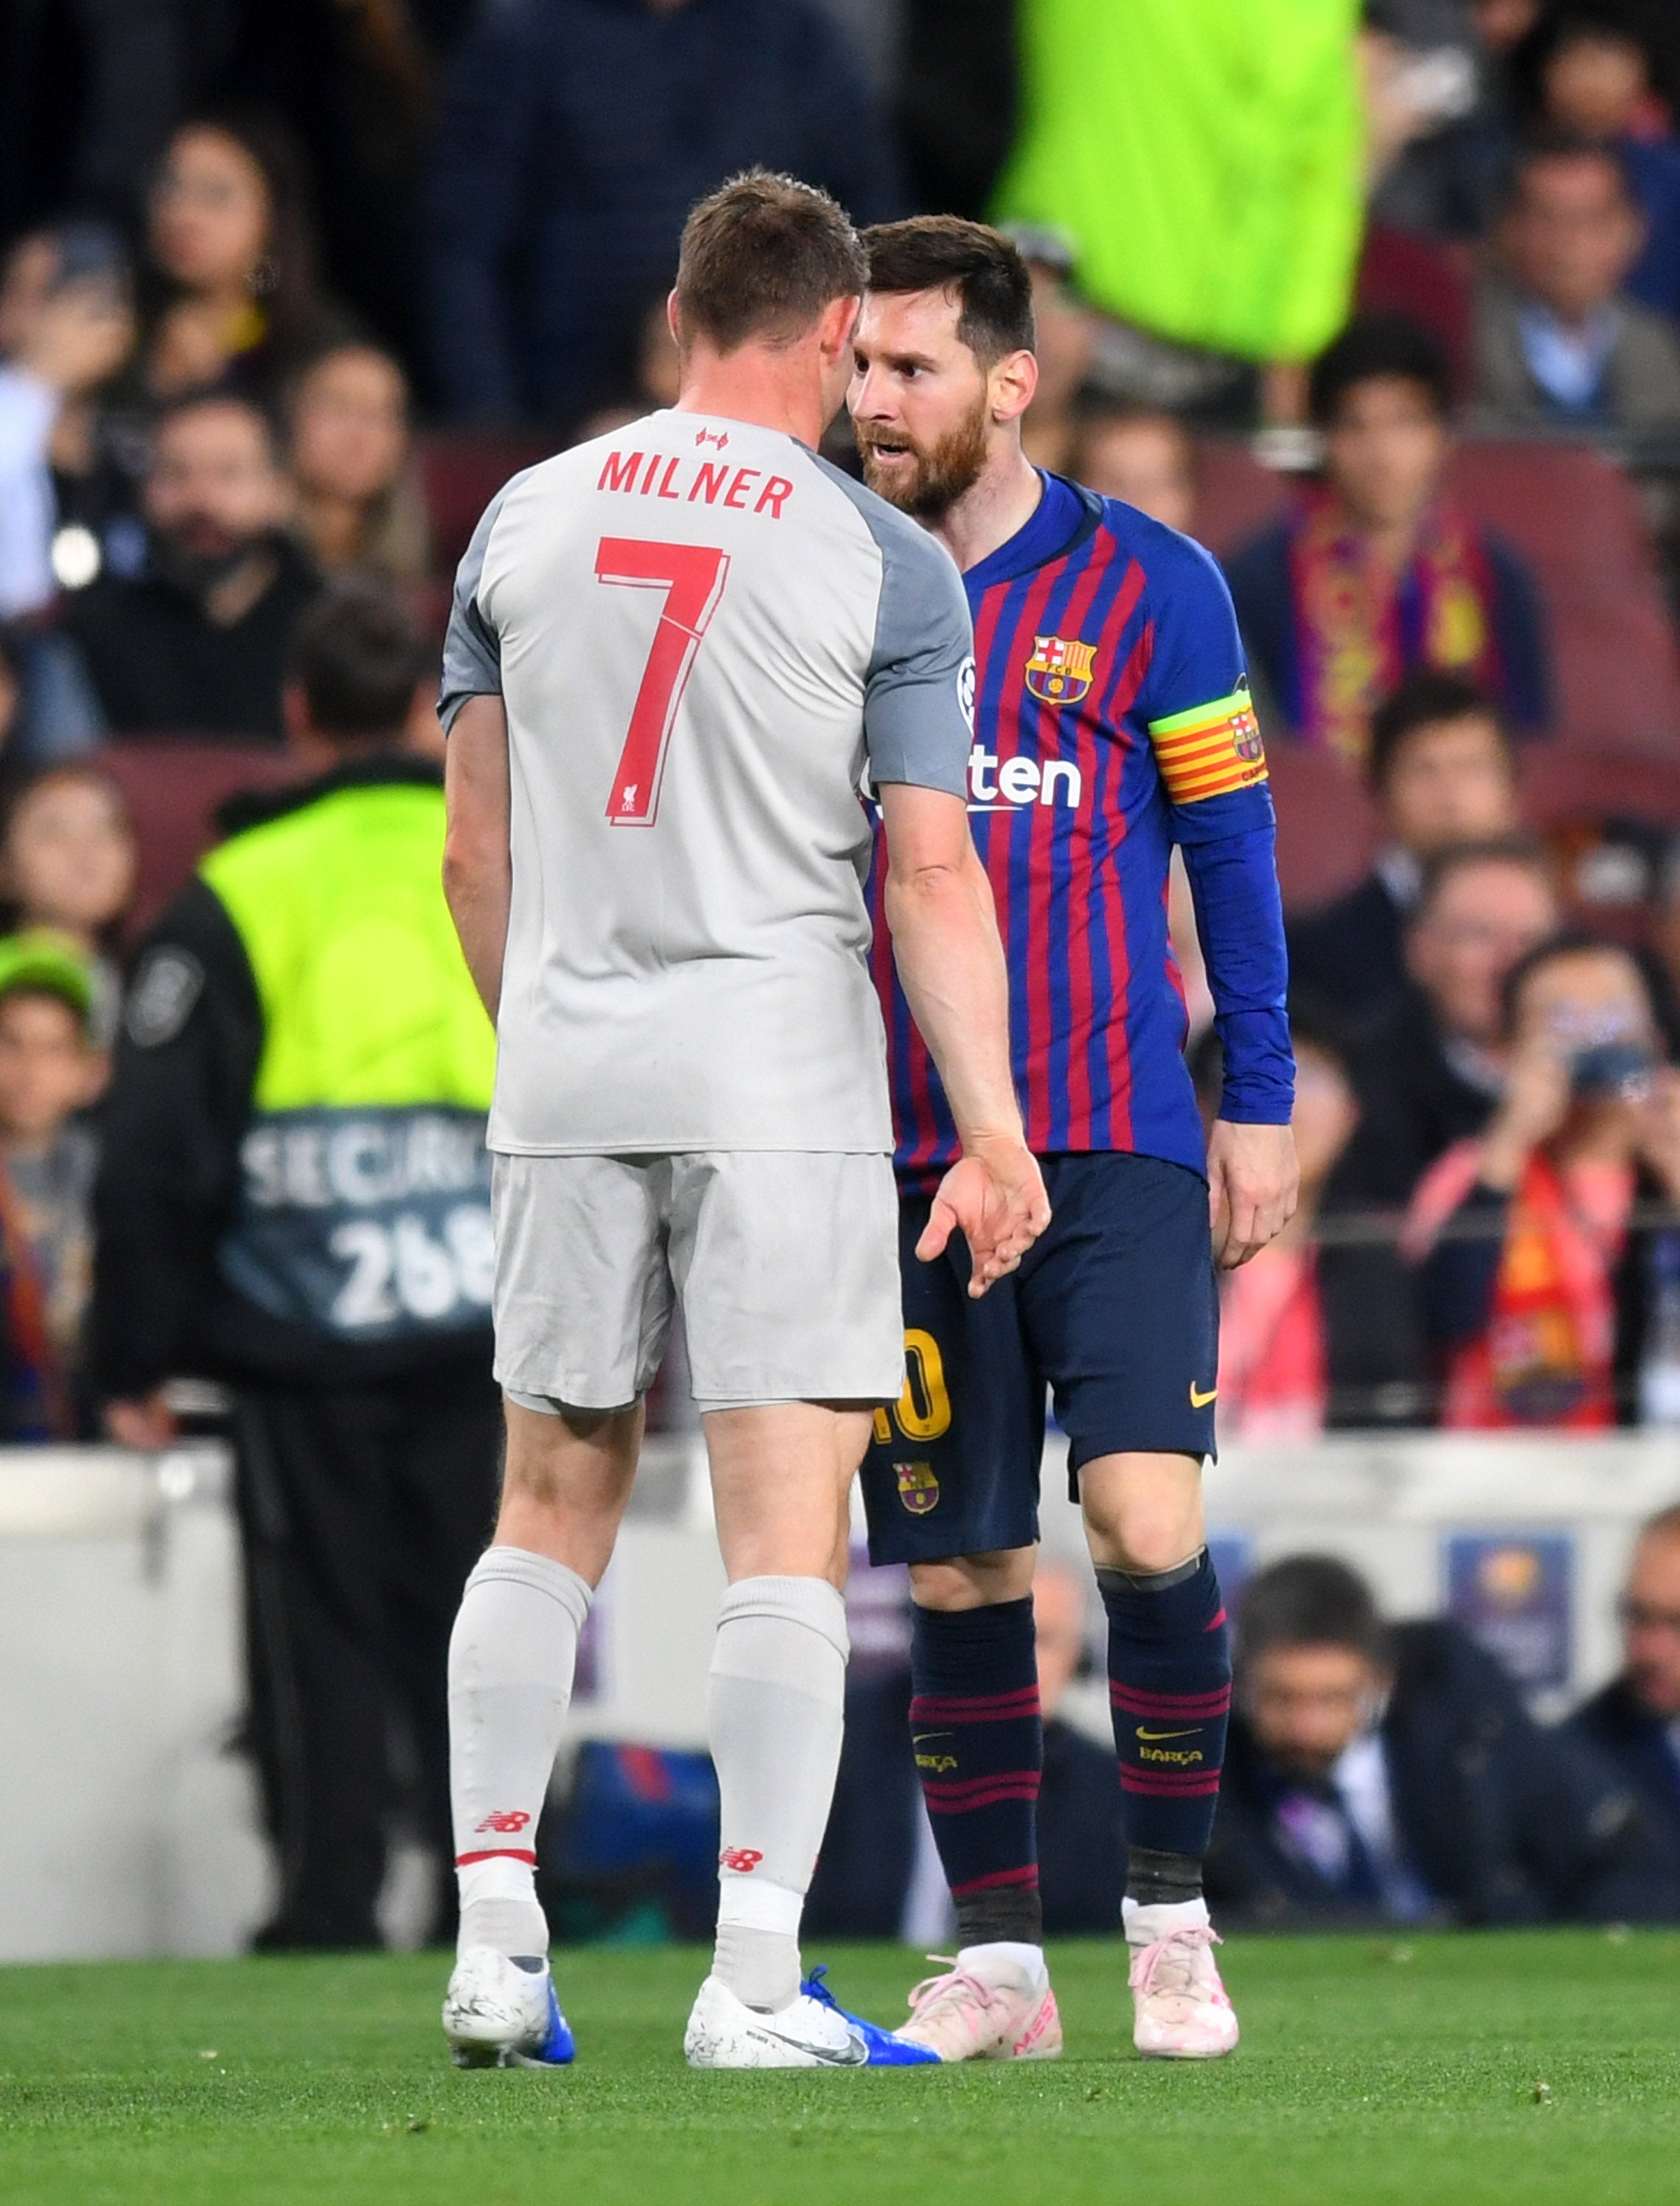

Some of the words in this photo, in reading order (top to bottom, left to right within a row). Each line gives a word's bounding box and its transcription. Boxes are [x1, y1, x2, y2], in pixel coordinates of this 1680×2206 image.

[596, 451, 793, 519] MILNER
[594, 536, 731, 827] 7
[328, 1204, 494, 1328] 268
[873, 1328, 952, 1444] 0
[1139, 1746, 1204, 1766] BARÇA
